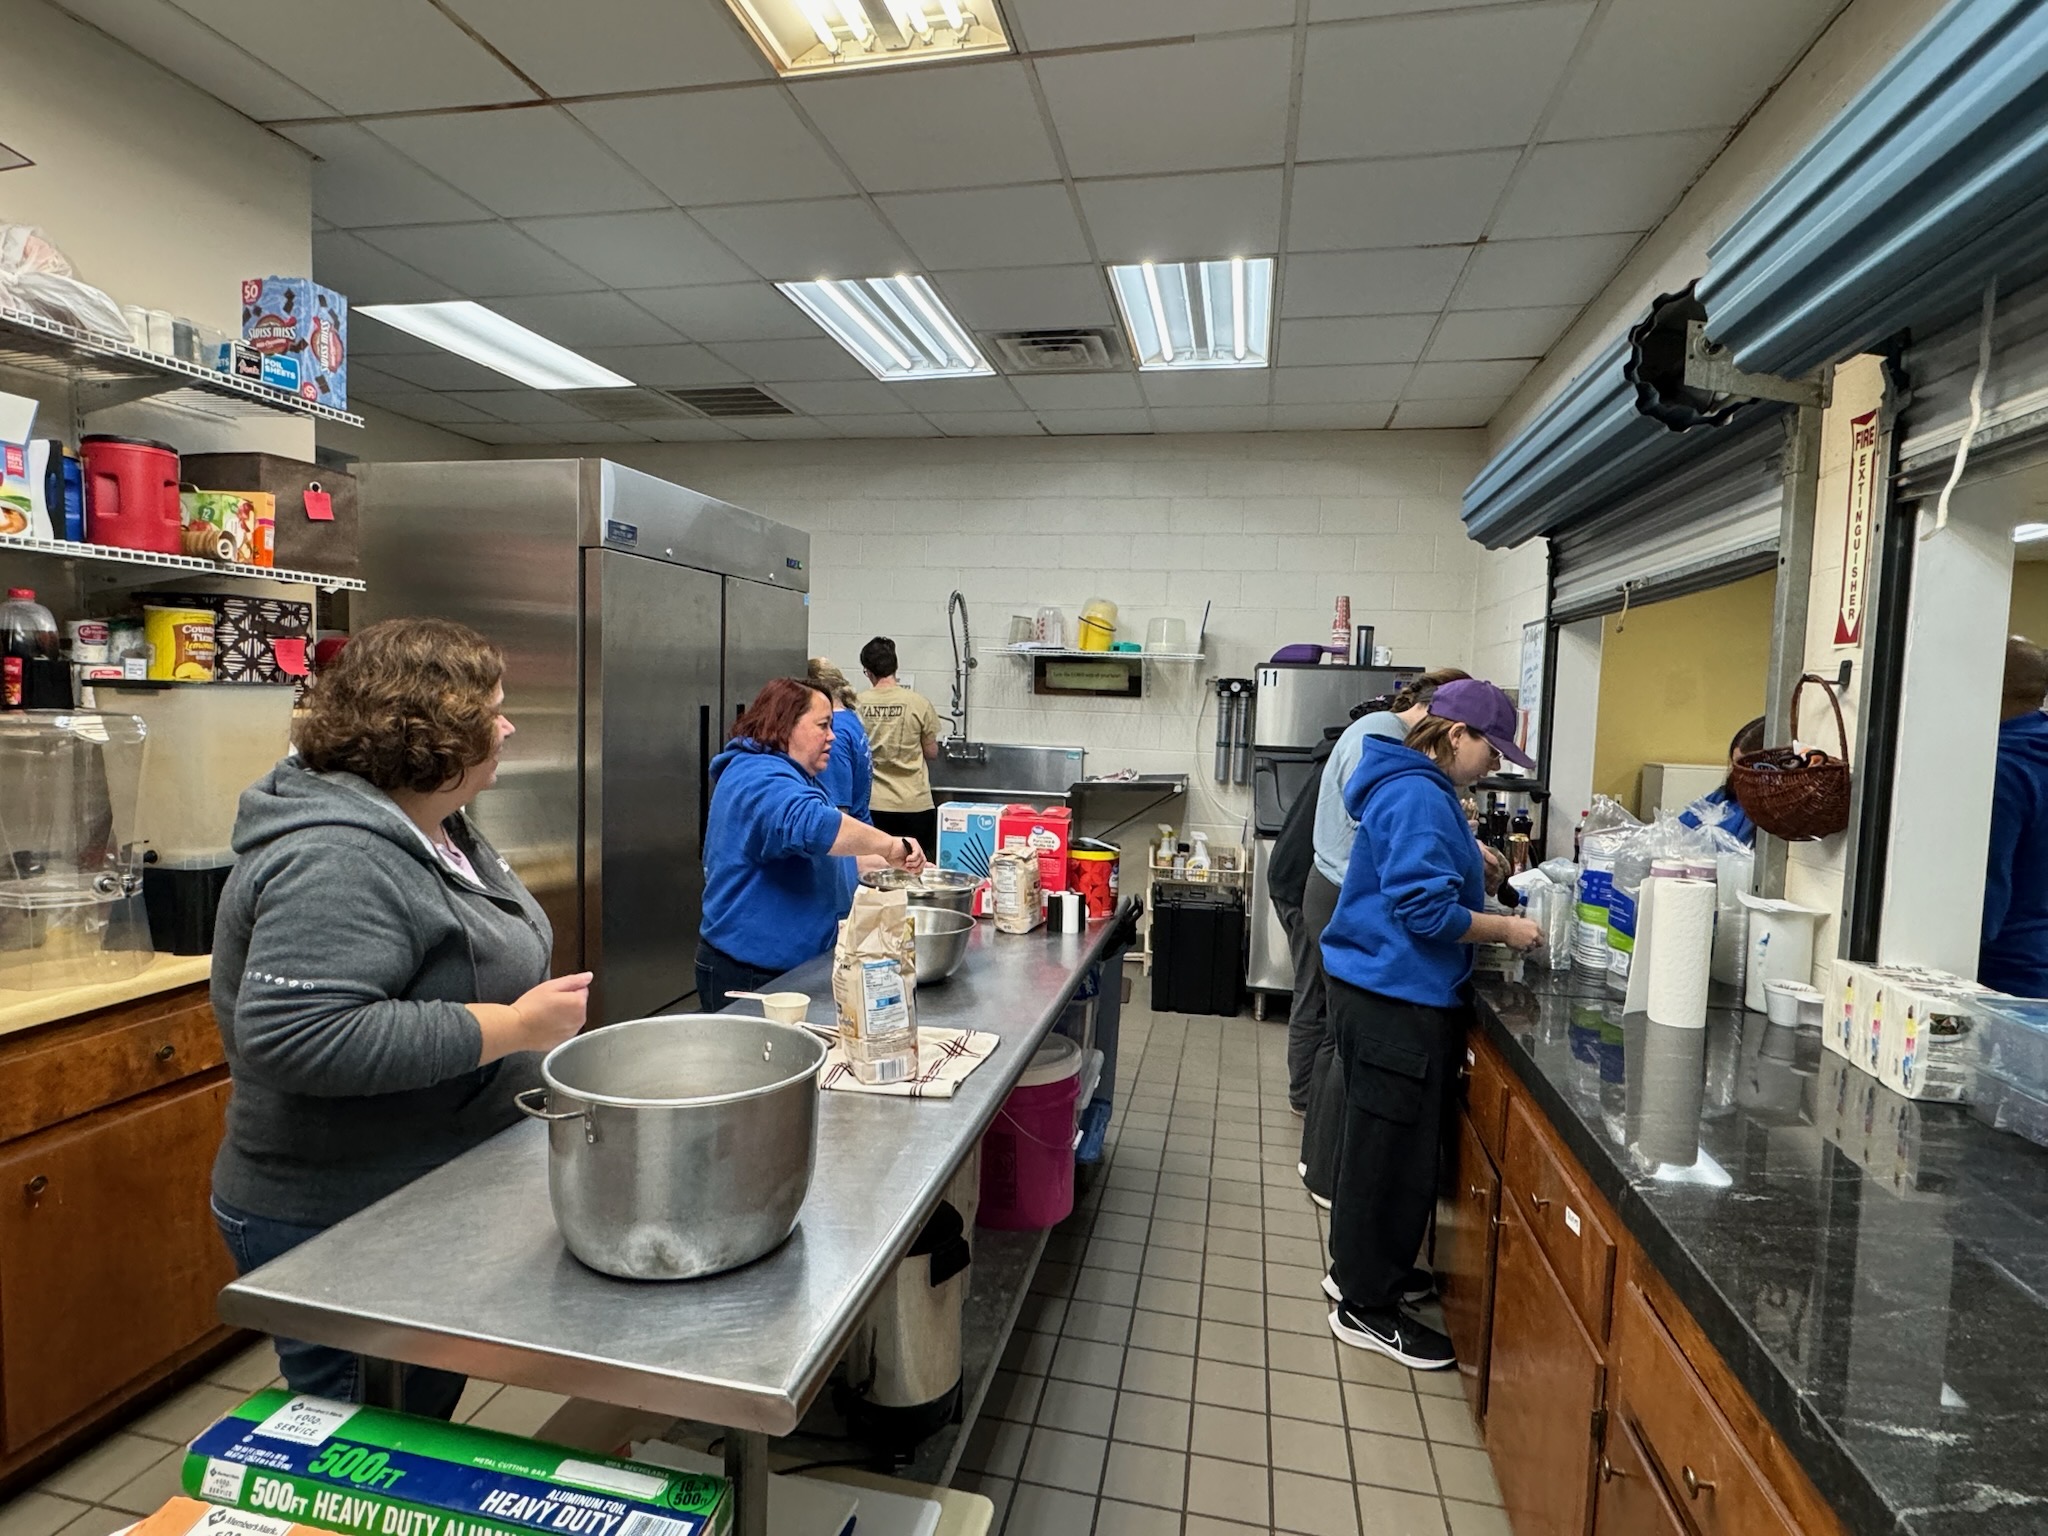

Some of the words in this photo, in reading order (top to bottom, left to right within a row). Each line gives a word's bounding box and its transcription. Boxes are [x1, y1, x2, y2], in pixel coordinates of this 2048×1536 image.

[244, 284, 259, 300] 50
[264, 358, 283, 369] FOIL
[264, 365, 296, 380] SHEETS
[1855, 425, 1875, 451] FIRE
[1848, 453, 1867, 620] EXTINGUISHER
[1263, 670, 1278, 687] 11
[274, 1422, 318, 1436] SERVICE
[308, 1442, 407, 1489] 500FT
[473, 1457, 496, 1467] METAL
[498, 1461, 529, 1473] CUTTING
[530, 1468, 547, 1477] BAR
[250, 1476, 309, 1515] 500FT
[312, 1489, 381, 1531] HEAVY
[382, 1505, 440, 1536] DUTY
[479, 1488, 559, 1524] HEAVY
[551, 1505, 622, 1536] DUTY
[546, 1488, 602, 1510] ALUMINUM
[600, 1499, 628, 1516] FOIL
